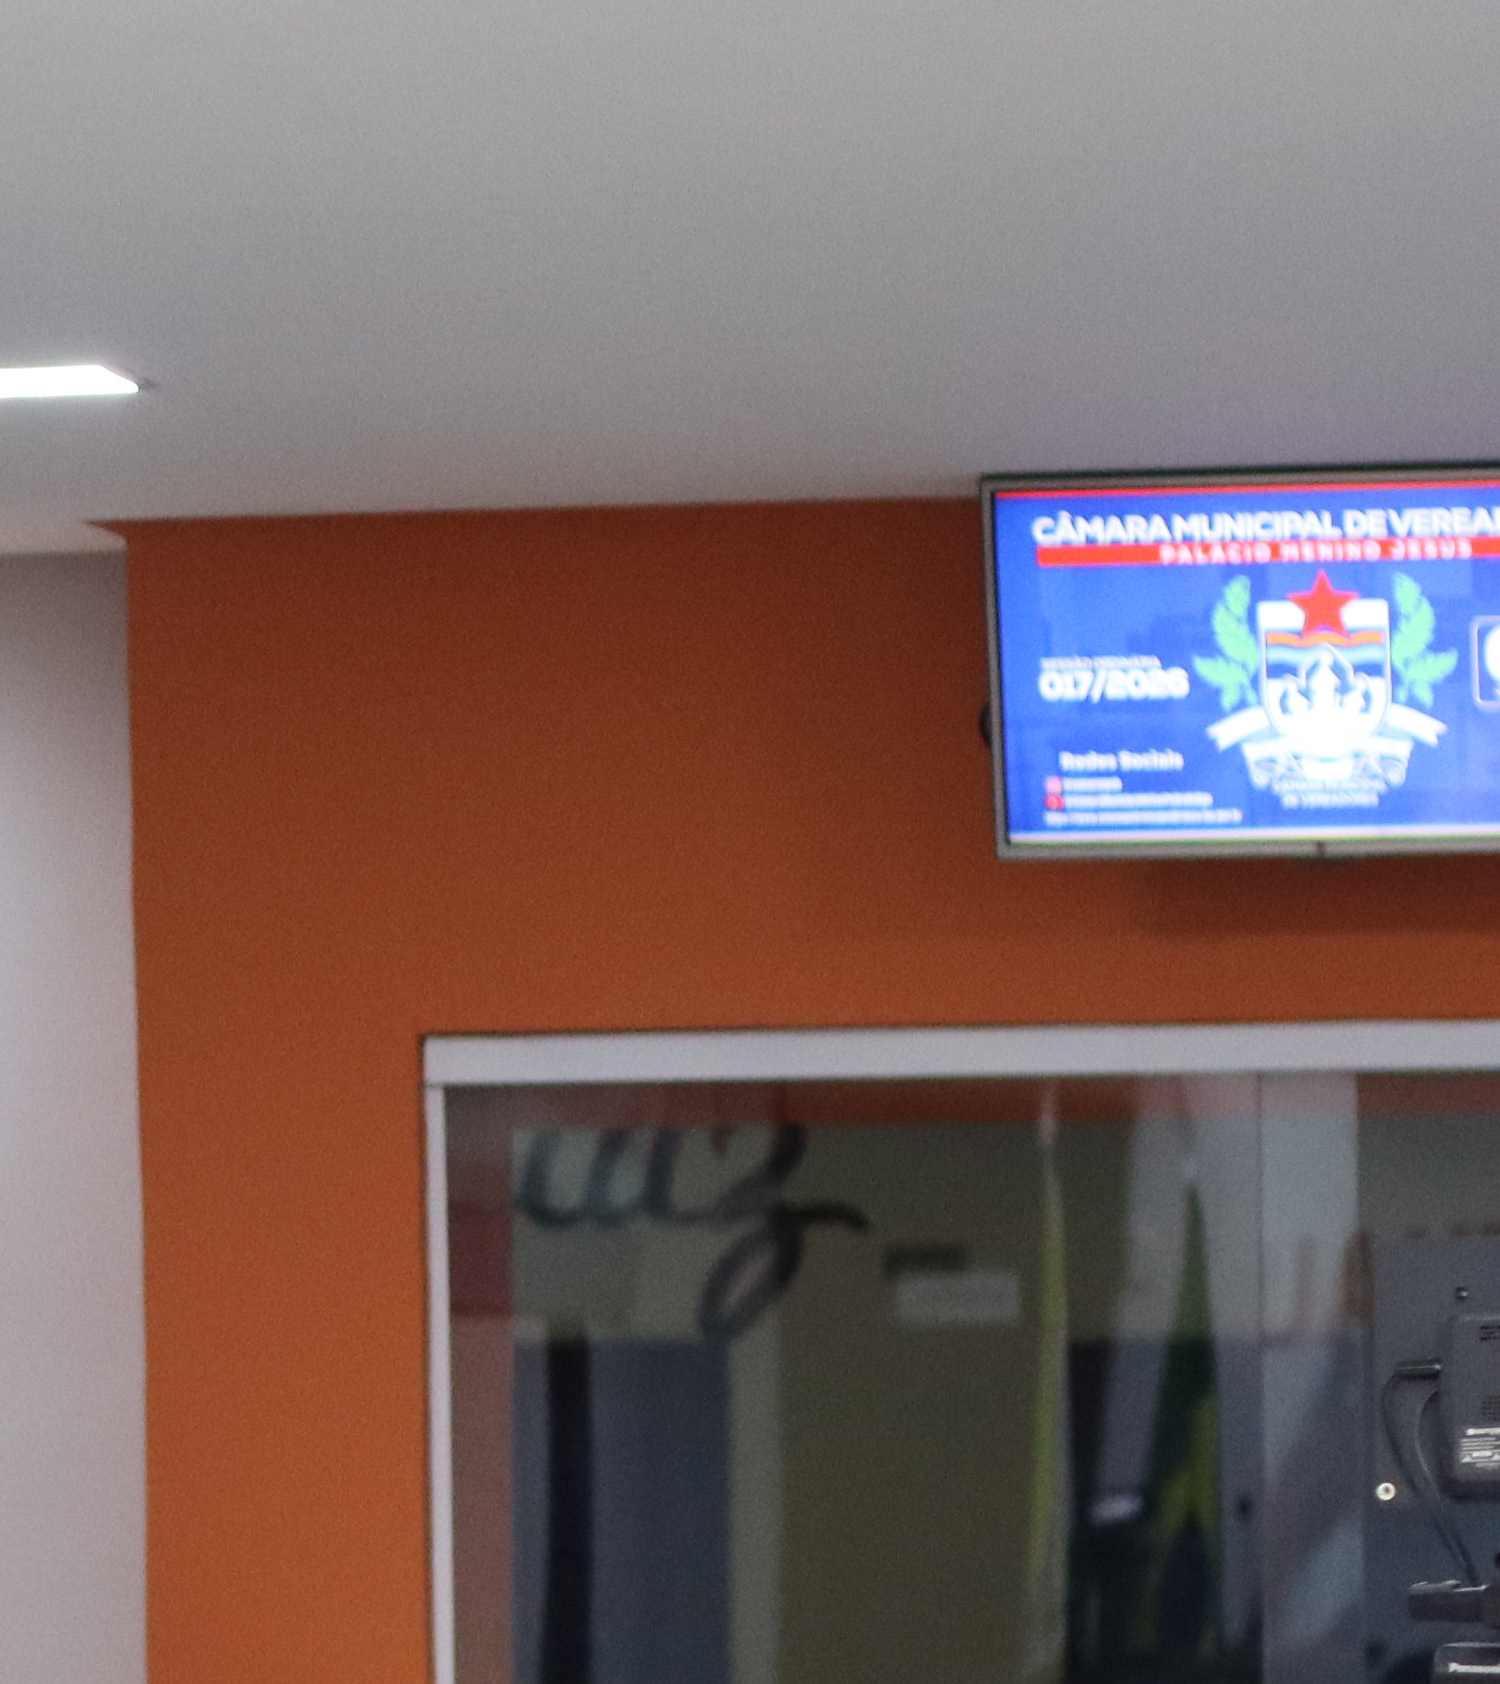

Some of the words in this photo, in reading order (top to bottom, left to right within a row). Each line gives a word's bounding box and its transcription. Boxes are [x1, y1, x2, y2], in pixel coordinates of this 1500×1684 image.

[1032, 510, 1172, 545] CÂMARA
[1172, 508, 1343, 542] MUNICIPAL
[1343, 507, 1388, 539] DE
[1388, 505, 1500, 538] VEREA
[1279, 538, 1381, 563] MENINO
[1388, 536, 1473, 561] JESUS
